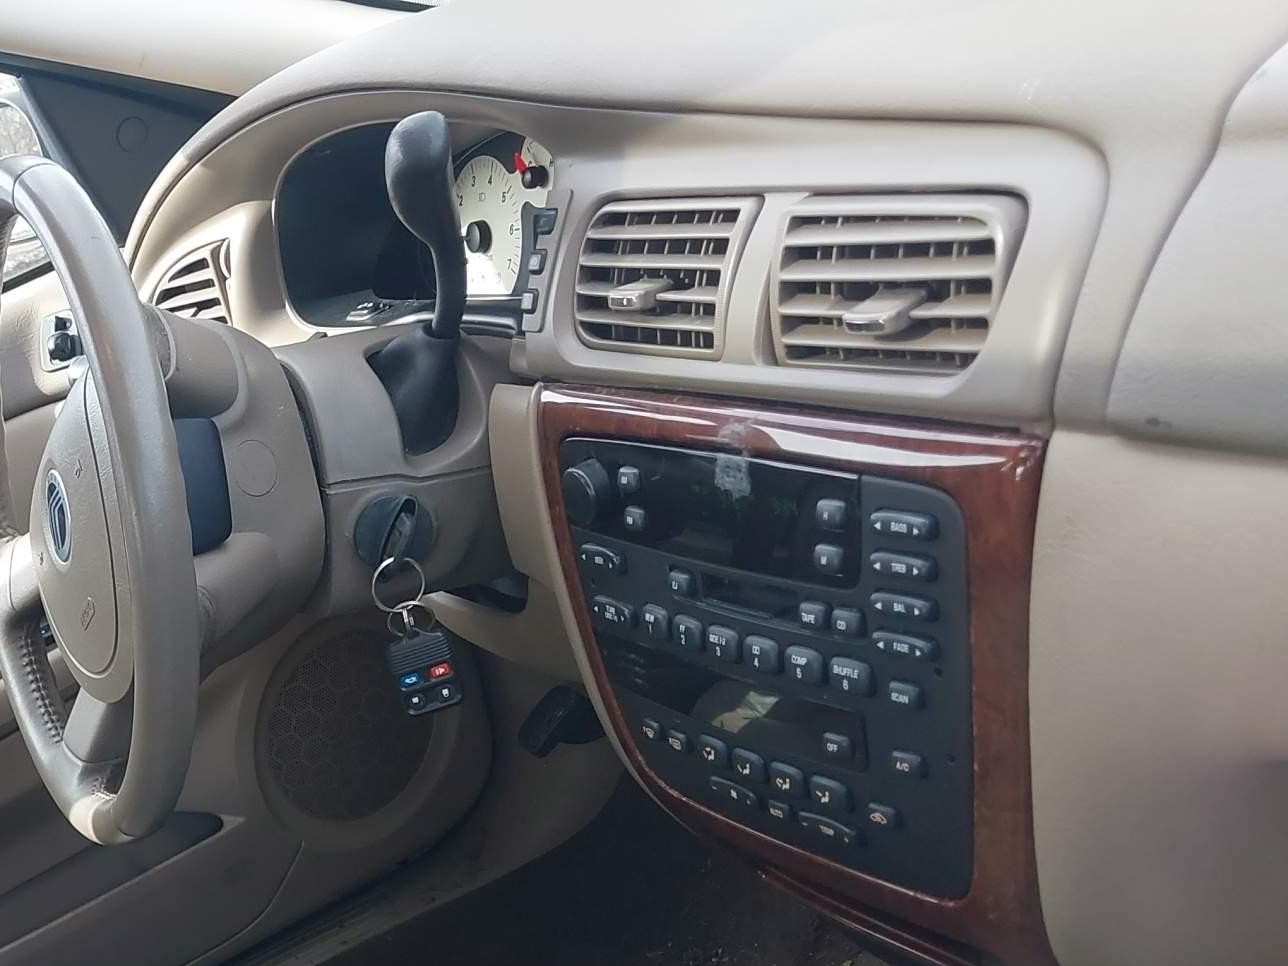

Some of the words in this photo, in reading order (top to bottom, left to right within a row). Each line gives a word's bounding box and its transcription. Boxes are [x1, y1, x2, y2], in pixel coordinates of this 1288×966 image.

[471, 175, 477, 188] 3
[487, 173, 493, 186] 4
[458, 195, 464, 207] 2
[501, 192, 507, 203] 5
[509, 224, 515, 236] 6
[507, 258, 513, 270] 7
[893, 602, 906, 614] BAL
[801, 612, 816, 624] TAPE
[836, 620, 847, 631] CD
[680, 634, 686, 645] 2
[715, 646, 721, 657] 3
[753, 657, 760, 669] 4
[791, 655, 808, 667] COMP
[796, 667, 802, 679] 5
[832, 664, 860, 680] SHUFFLE
[842, 679, 849, 691] 6
[826, 742, 838, 752] OFF
[895, 760, 910, 772] A/C
